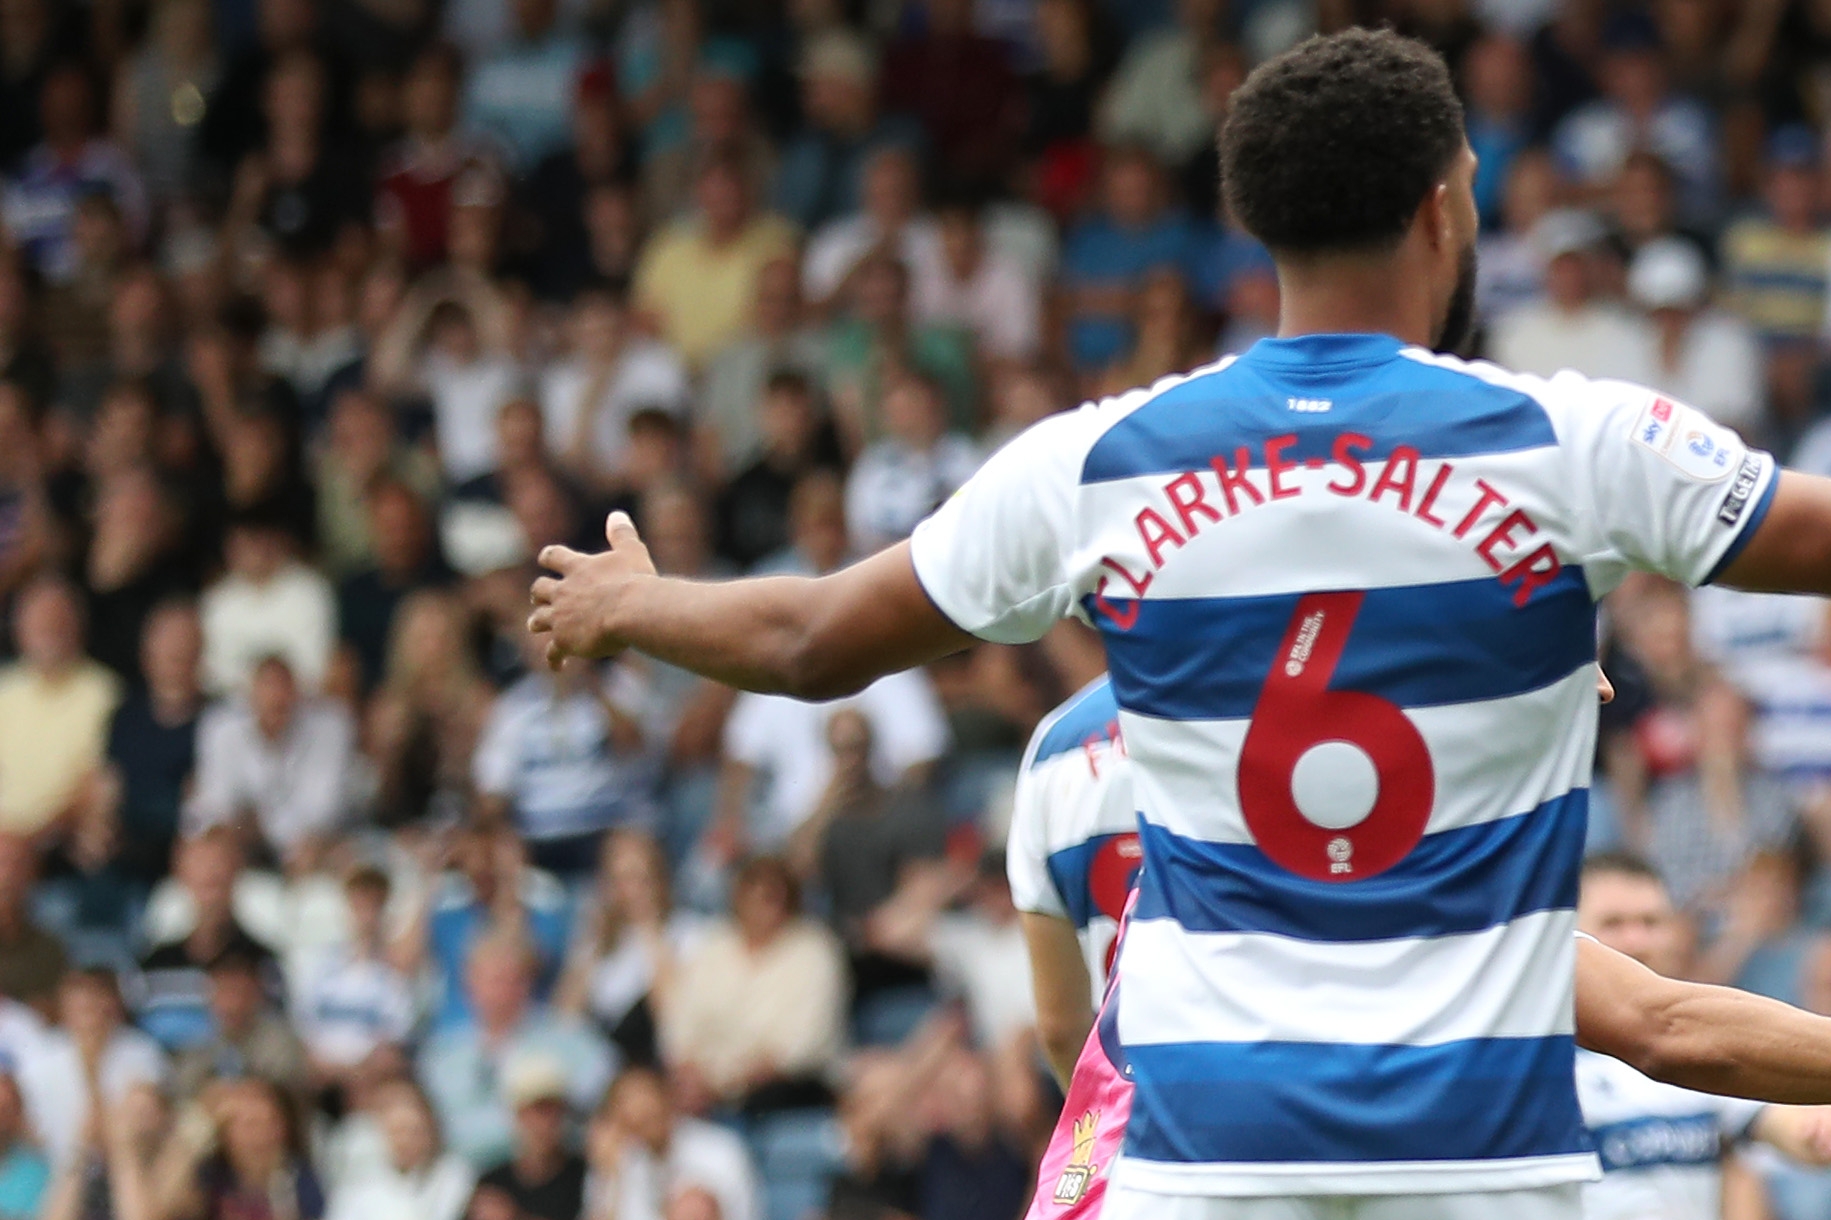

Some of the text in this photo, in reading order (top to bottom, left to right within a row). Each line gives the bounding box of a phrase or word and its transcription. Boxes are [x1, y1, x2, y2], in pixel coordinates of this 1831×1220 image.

[1287, 398, 1332, 412] 1882
[1095, 432, 1564, 630] CLARKE-SALTER
[1238, 592, 1435, 883] 6
